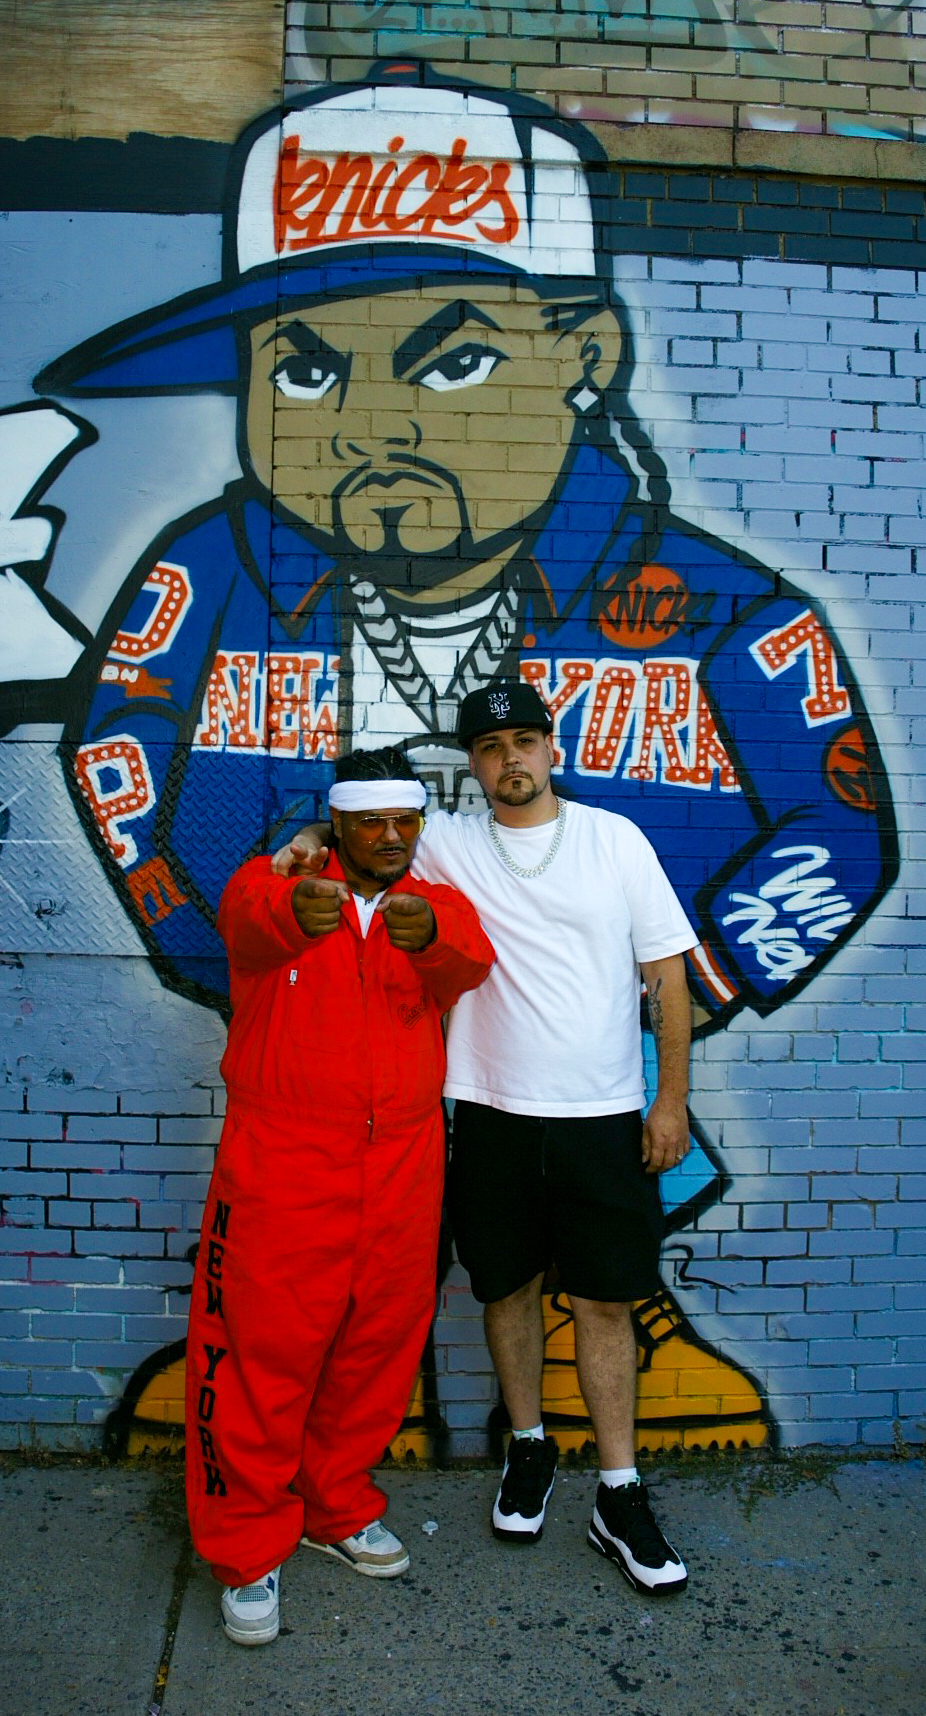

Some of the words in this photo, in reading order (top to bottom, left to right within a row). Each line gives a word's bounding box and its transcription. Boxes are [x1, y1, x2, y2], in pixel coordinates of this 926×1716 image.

[191, 649, 341, 762] NEW
[519, 656, 743, 793] YORK
[487, 691, 511, 720] NY
[205, 1199, 231, 1319] NEW
[198, 1343, 228, 1497] YORK
